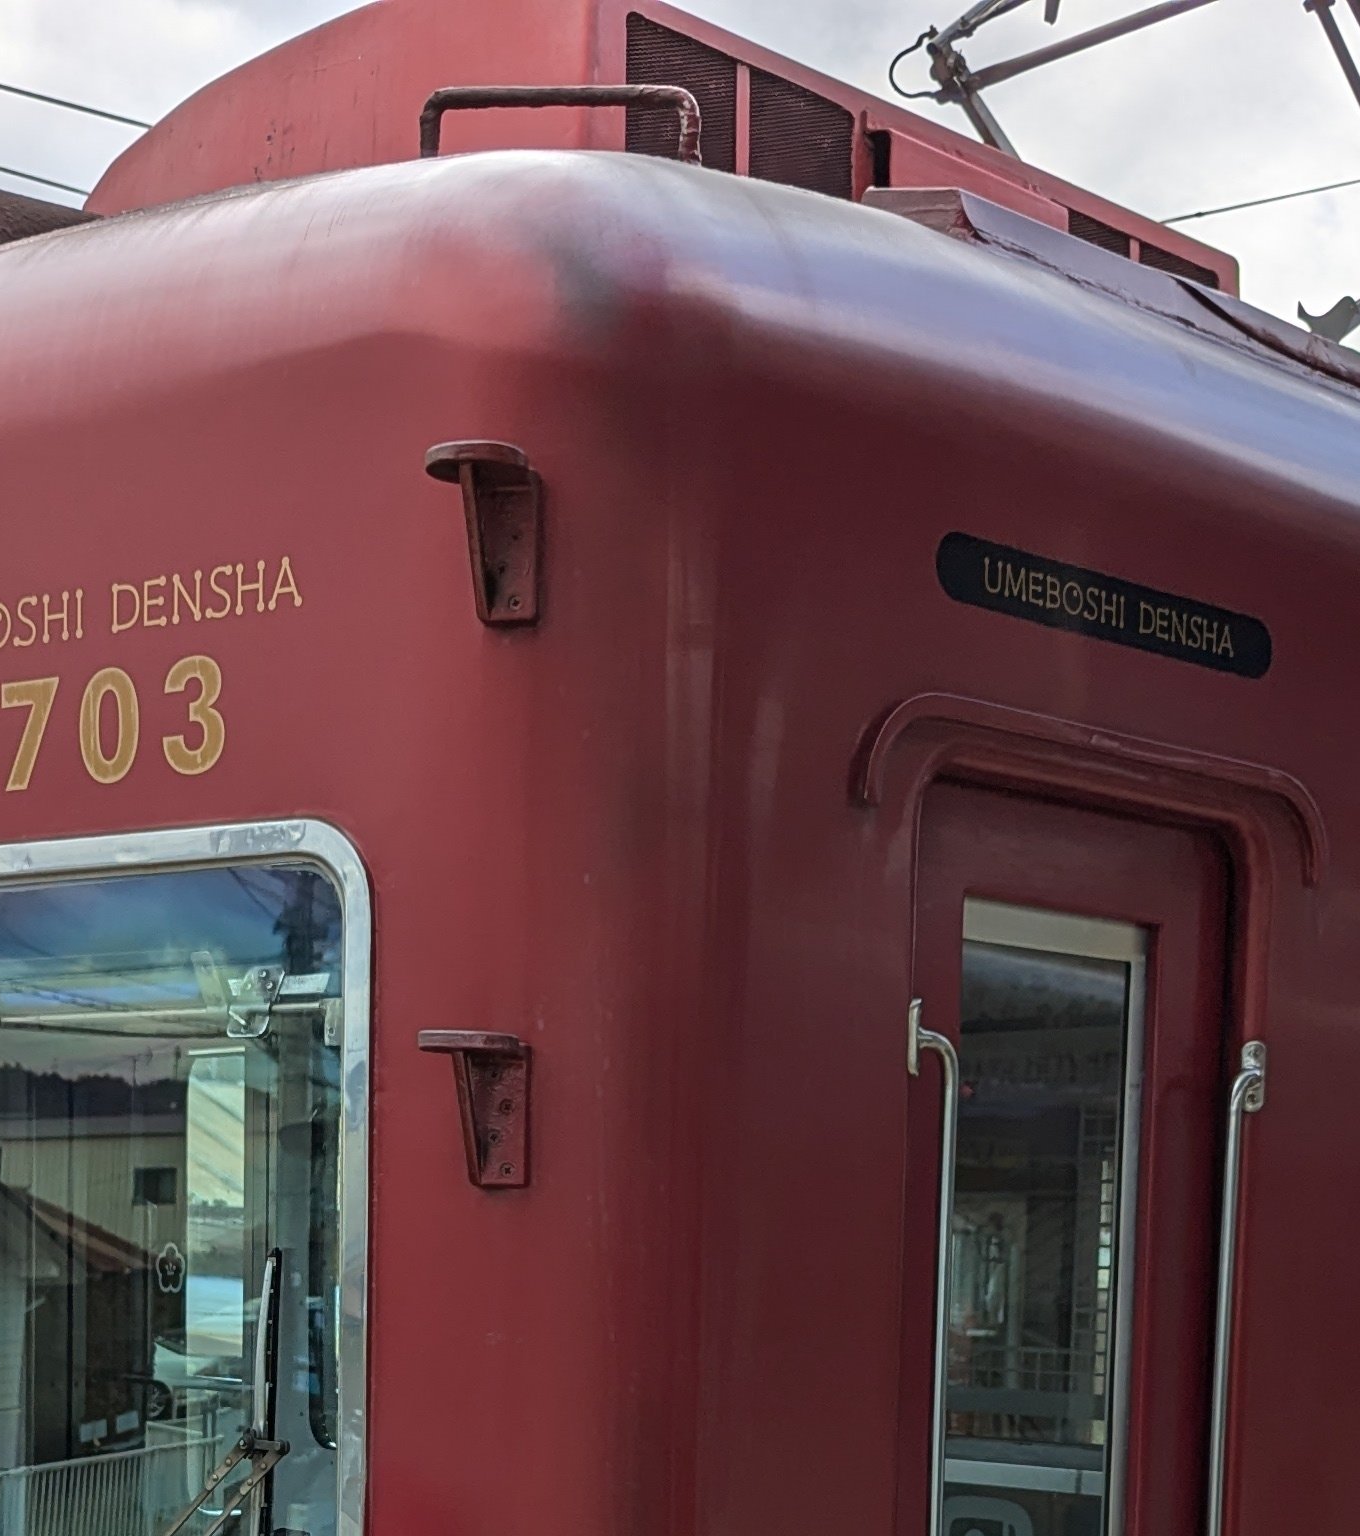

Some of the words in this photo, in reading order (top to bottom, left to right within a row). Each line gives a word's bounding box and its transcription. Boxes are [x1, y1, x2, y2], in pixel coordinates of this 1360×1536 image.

[110, 555, 304, 634] DENSHA
[983, 556, 1126, 630] UMEBOSHI
[1138, 600, 1235, 658] DENSHA
